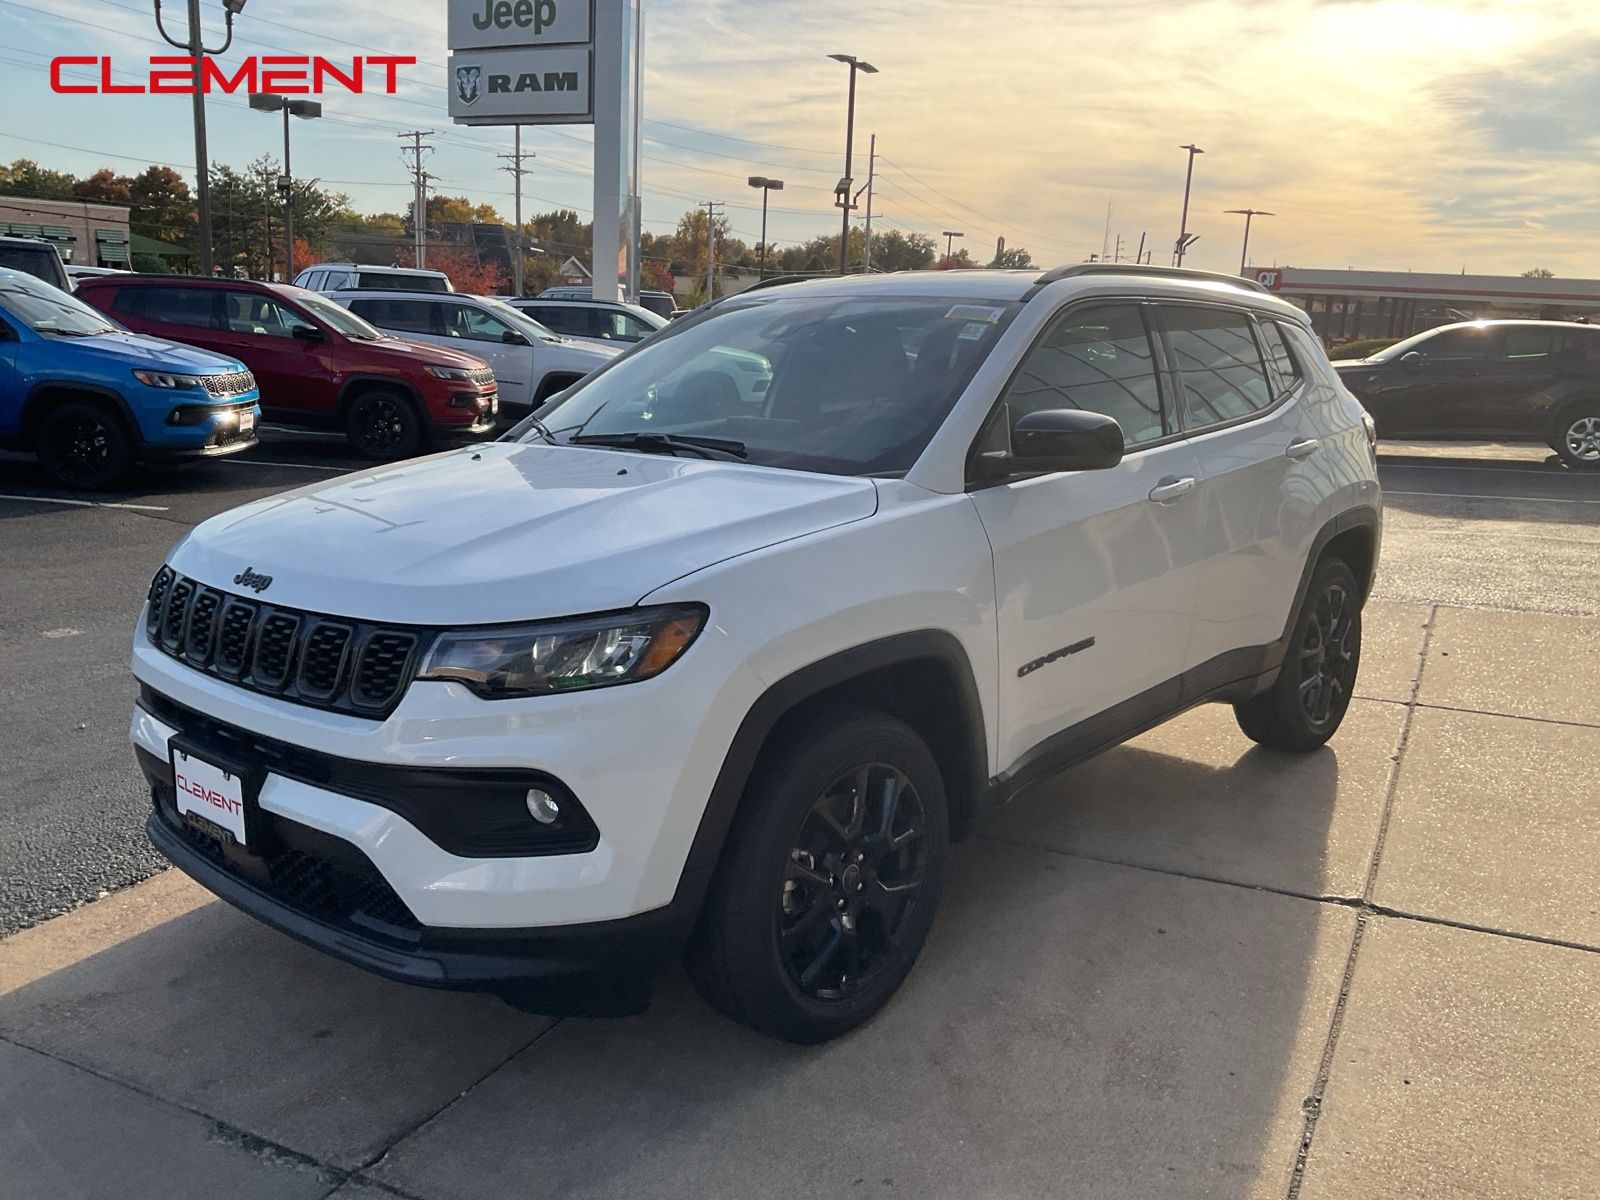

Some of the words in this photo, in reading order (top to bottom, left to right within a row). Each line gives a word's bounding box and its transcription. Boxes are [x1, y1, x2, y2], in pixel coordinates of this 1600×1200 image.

[472, 0, 556, 35] Jeep
[488, 72, 578, 93] RAM
[1258, 272, 1277, 287] QT
[233, 566, 273, 593] Jeep
[177, 774, 241, 816] CLEMENT
